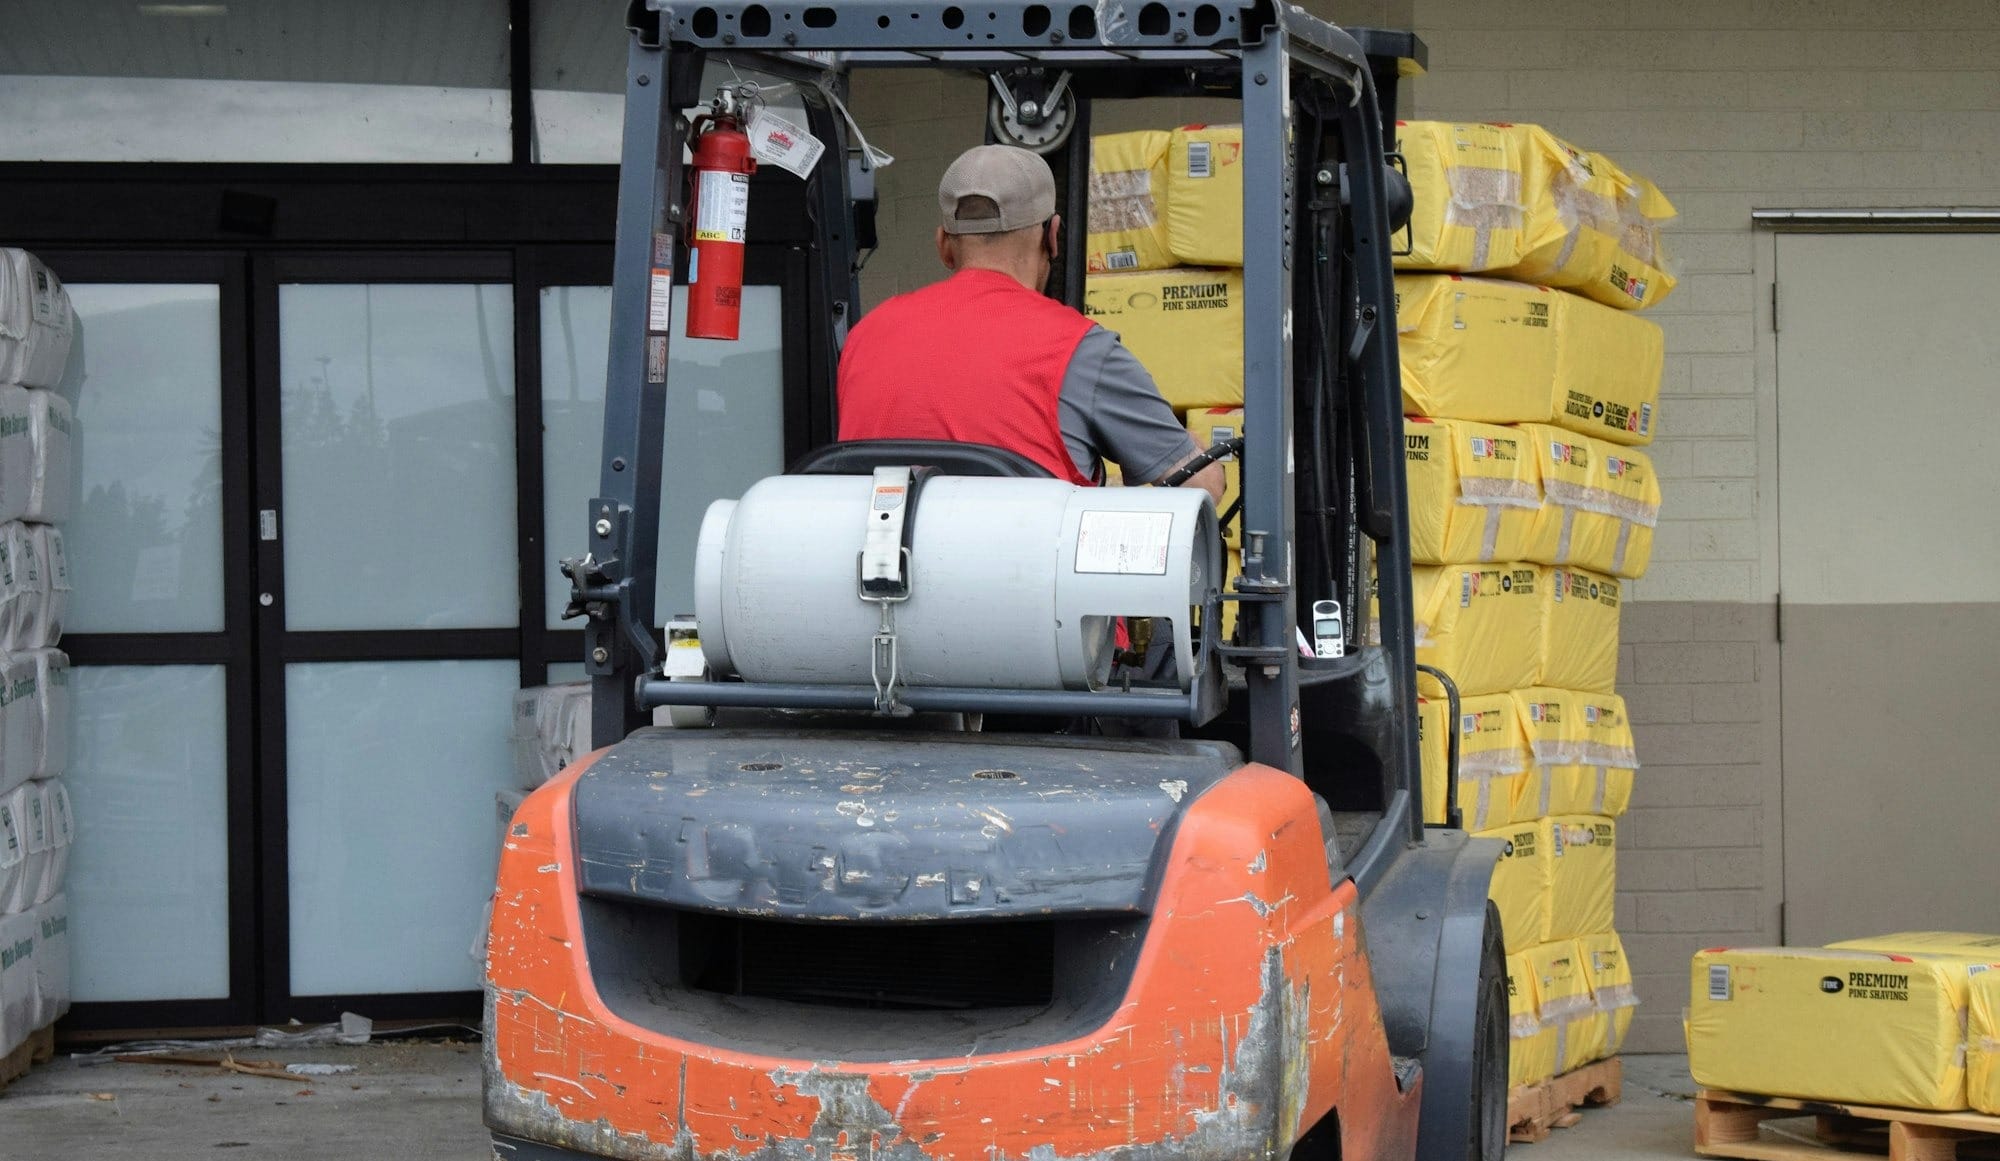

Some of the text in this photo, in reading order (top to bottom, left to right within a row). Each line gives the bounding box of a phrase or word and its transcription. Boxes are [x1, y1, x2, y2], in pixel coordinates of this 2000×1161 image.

[701, 231, 720, 239] ABC
[1162, 283, 1228, 299] PREMIUM
[1162, 299, 1229, 311] PINE SHAVINGS
[1849, 972, 1908, 989] PREMIUM
[1848, 989, 1908, 1001] PINE SHAVINGS
